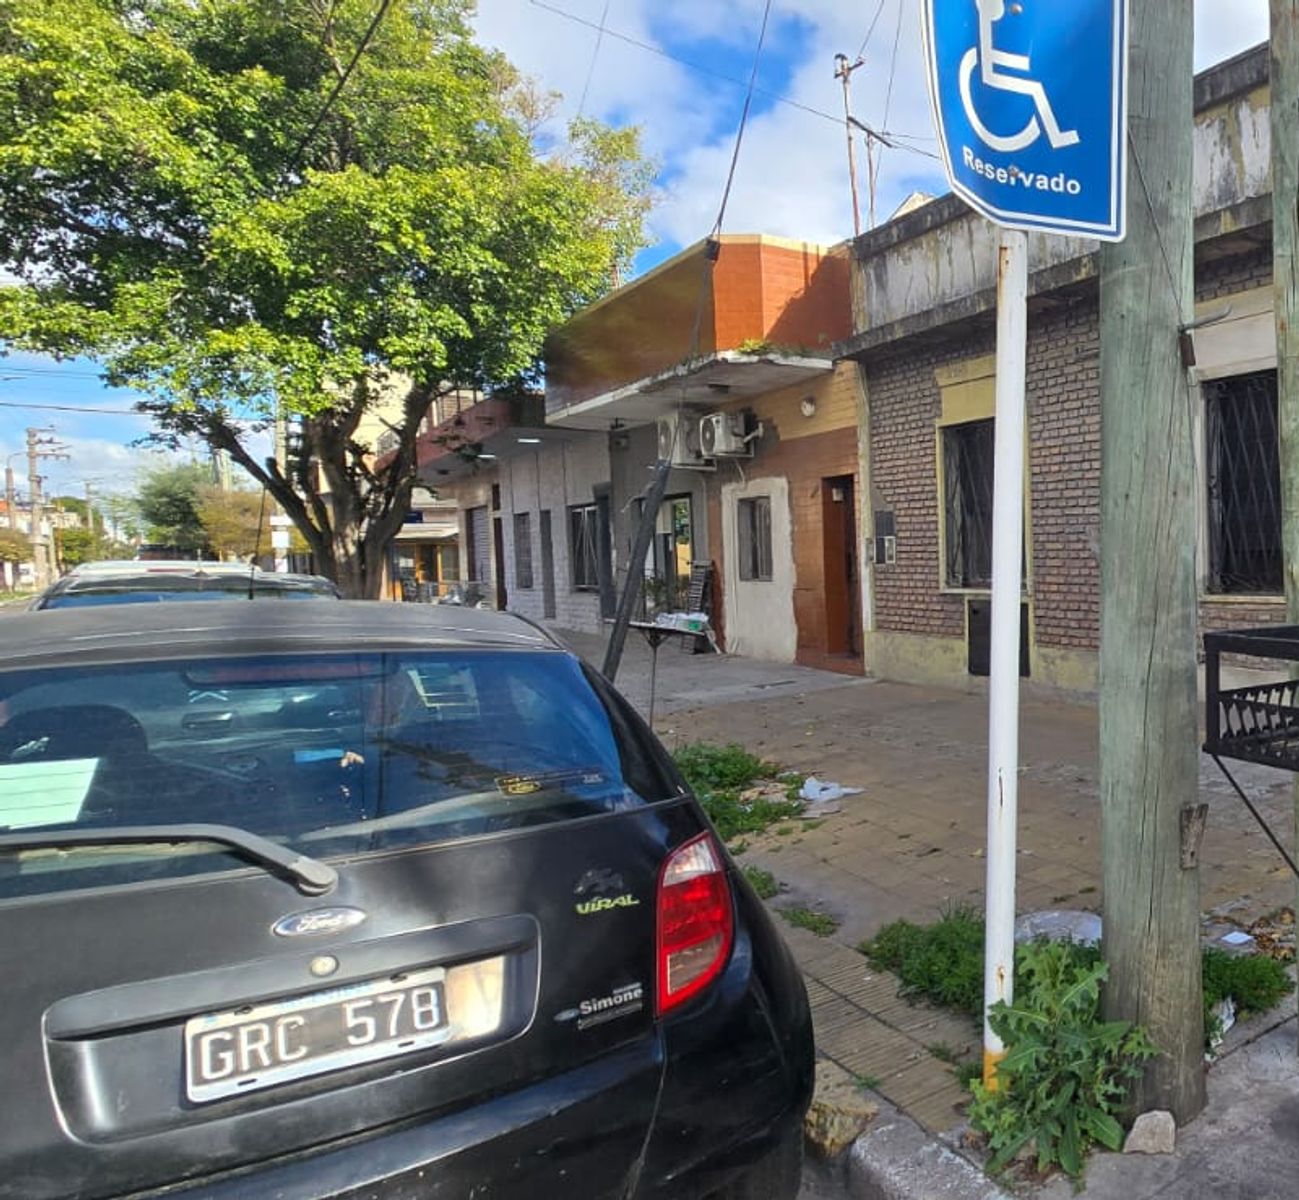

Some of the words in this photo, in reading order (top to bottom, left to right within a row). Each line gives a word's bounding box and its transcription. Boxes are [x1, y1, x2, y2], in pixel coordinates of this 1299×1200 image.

[579, 988, 643, 1015] Simone
[200, 1015, 308, 1080] GRC
[342, 987, 440, 1046] 578
